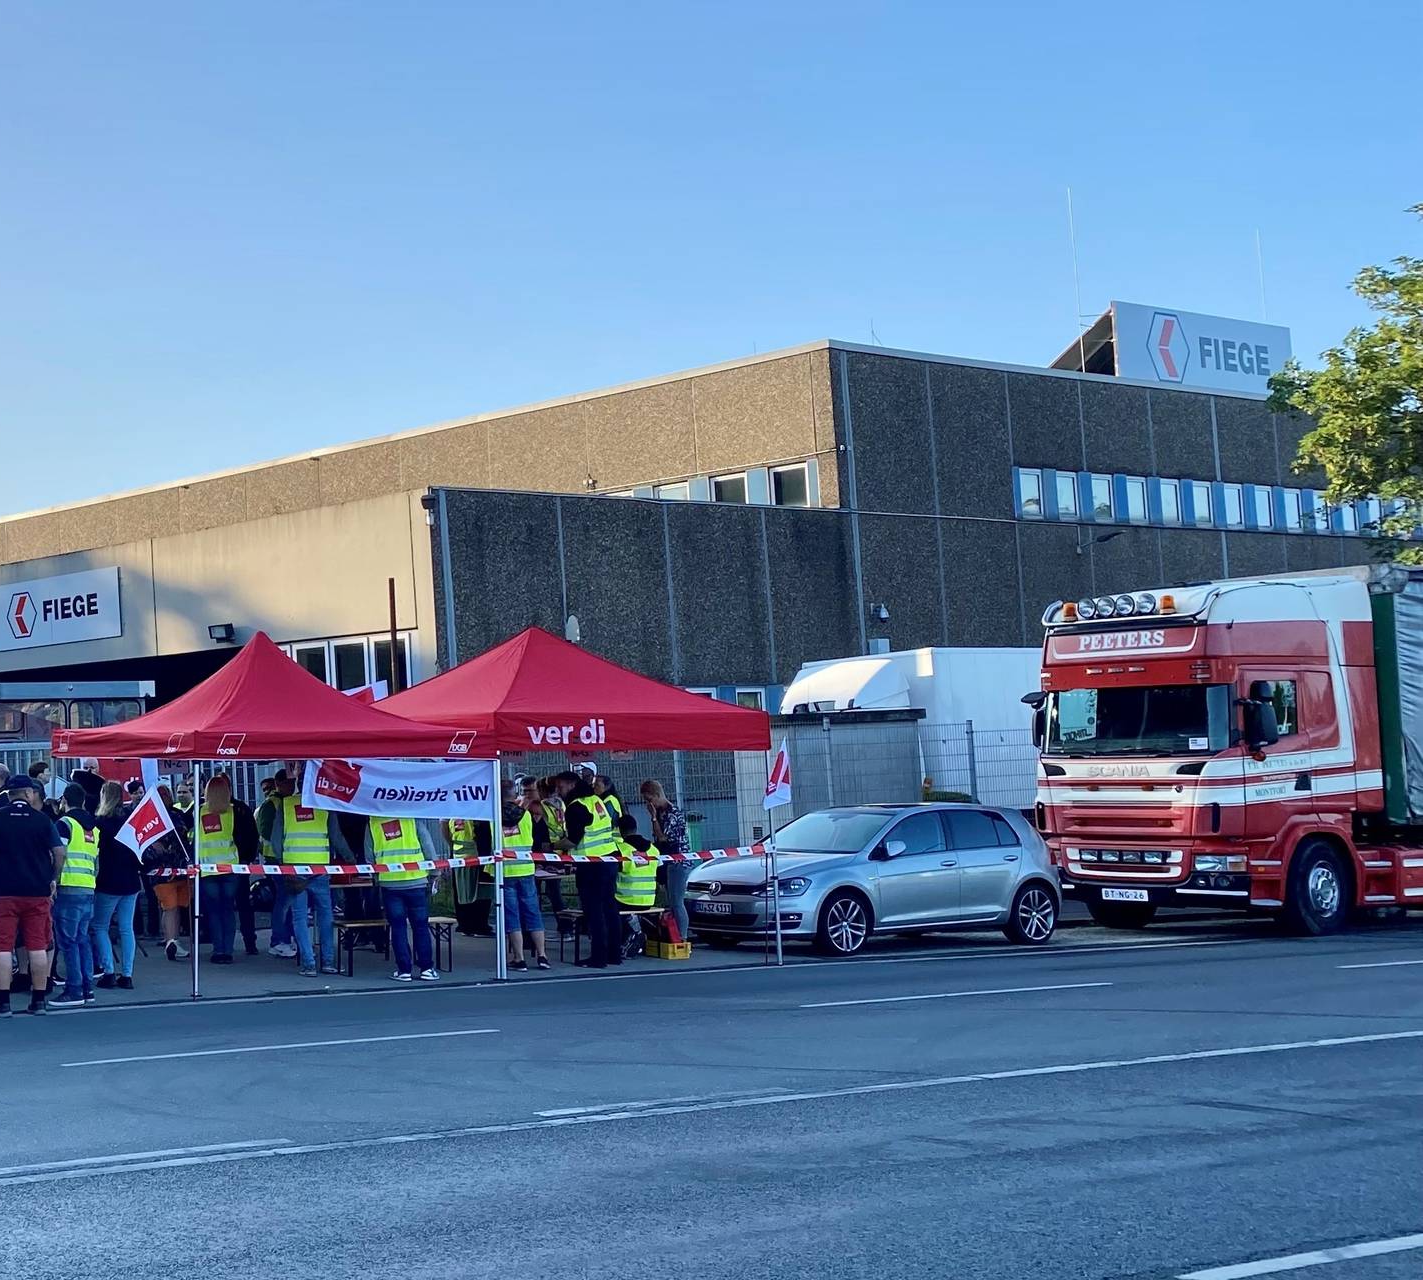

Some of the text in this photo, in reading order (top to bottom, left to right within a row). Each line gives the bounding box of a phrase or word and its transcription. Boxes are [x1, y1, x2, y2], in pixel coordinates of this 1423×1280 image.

[1198, 336, 1271, 376] FIEGE
[42, 593, 99, 622] FIEGE
[1078, 630, 1165, 651] PEETERS
[1088, 765, 1150, 777] SCANIA
